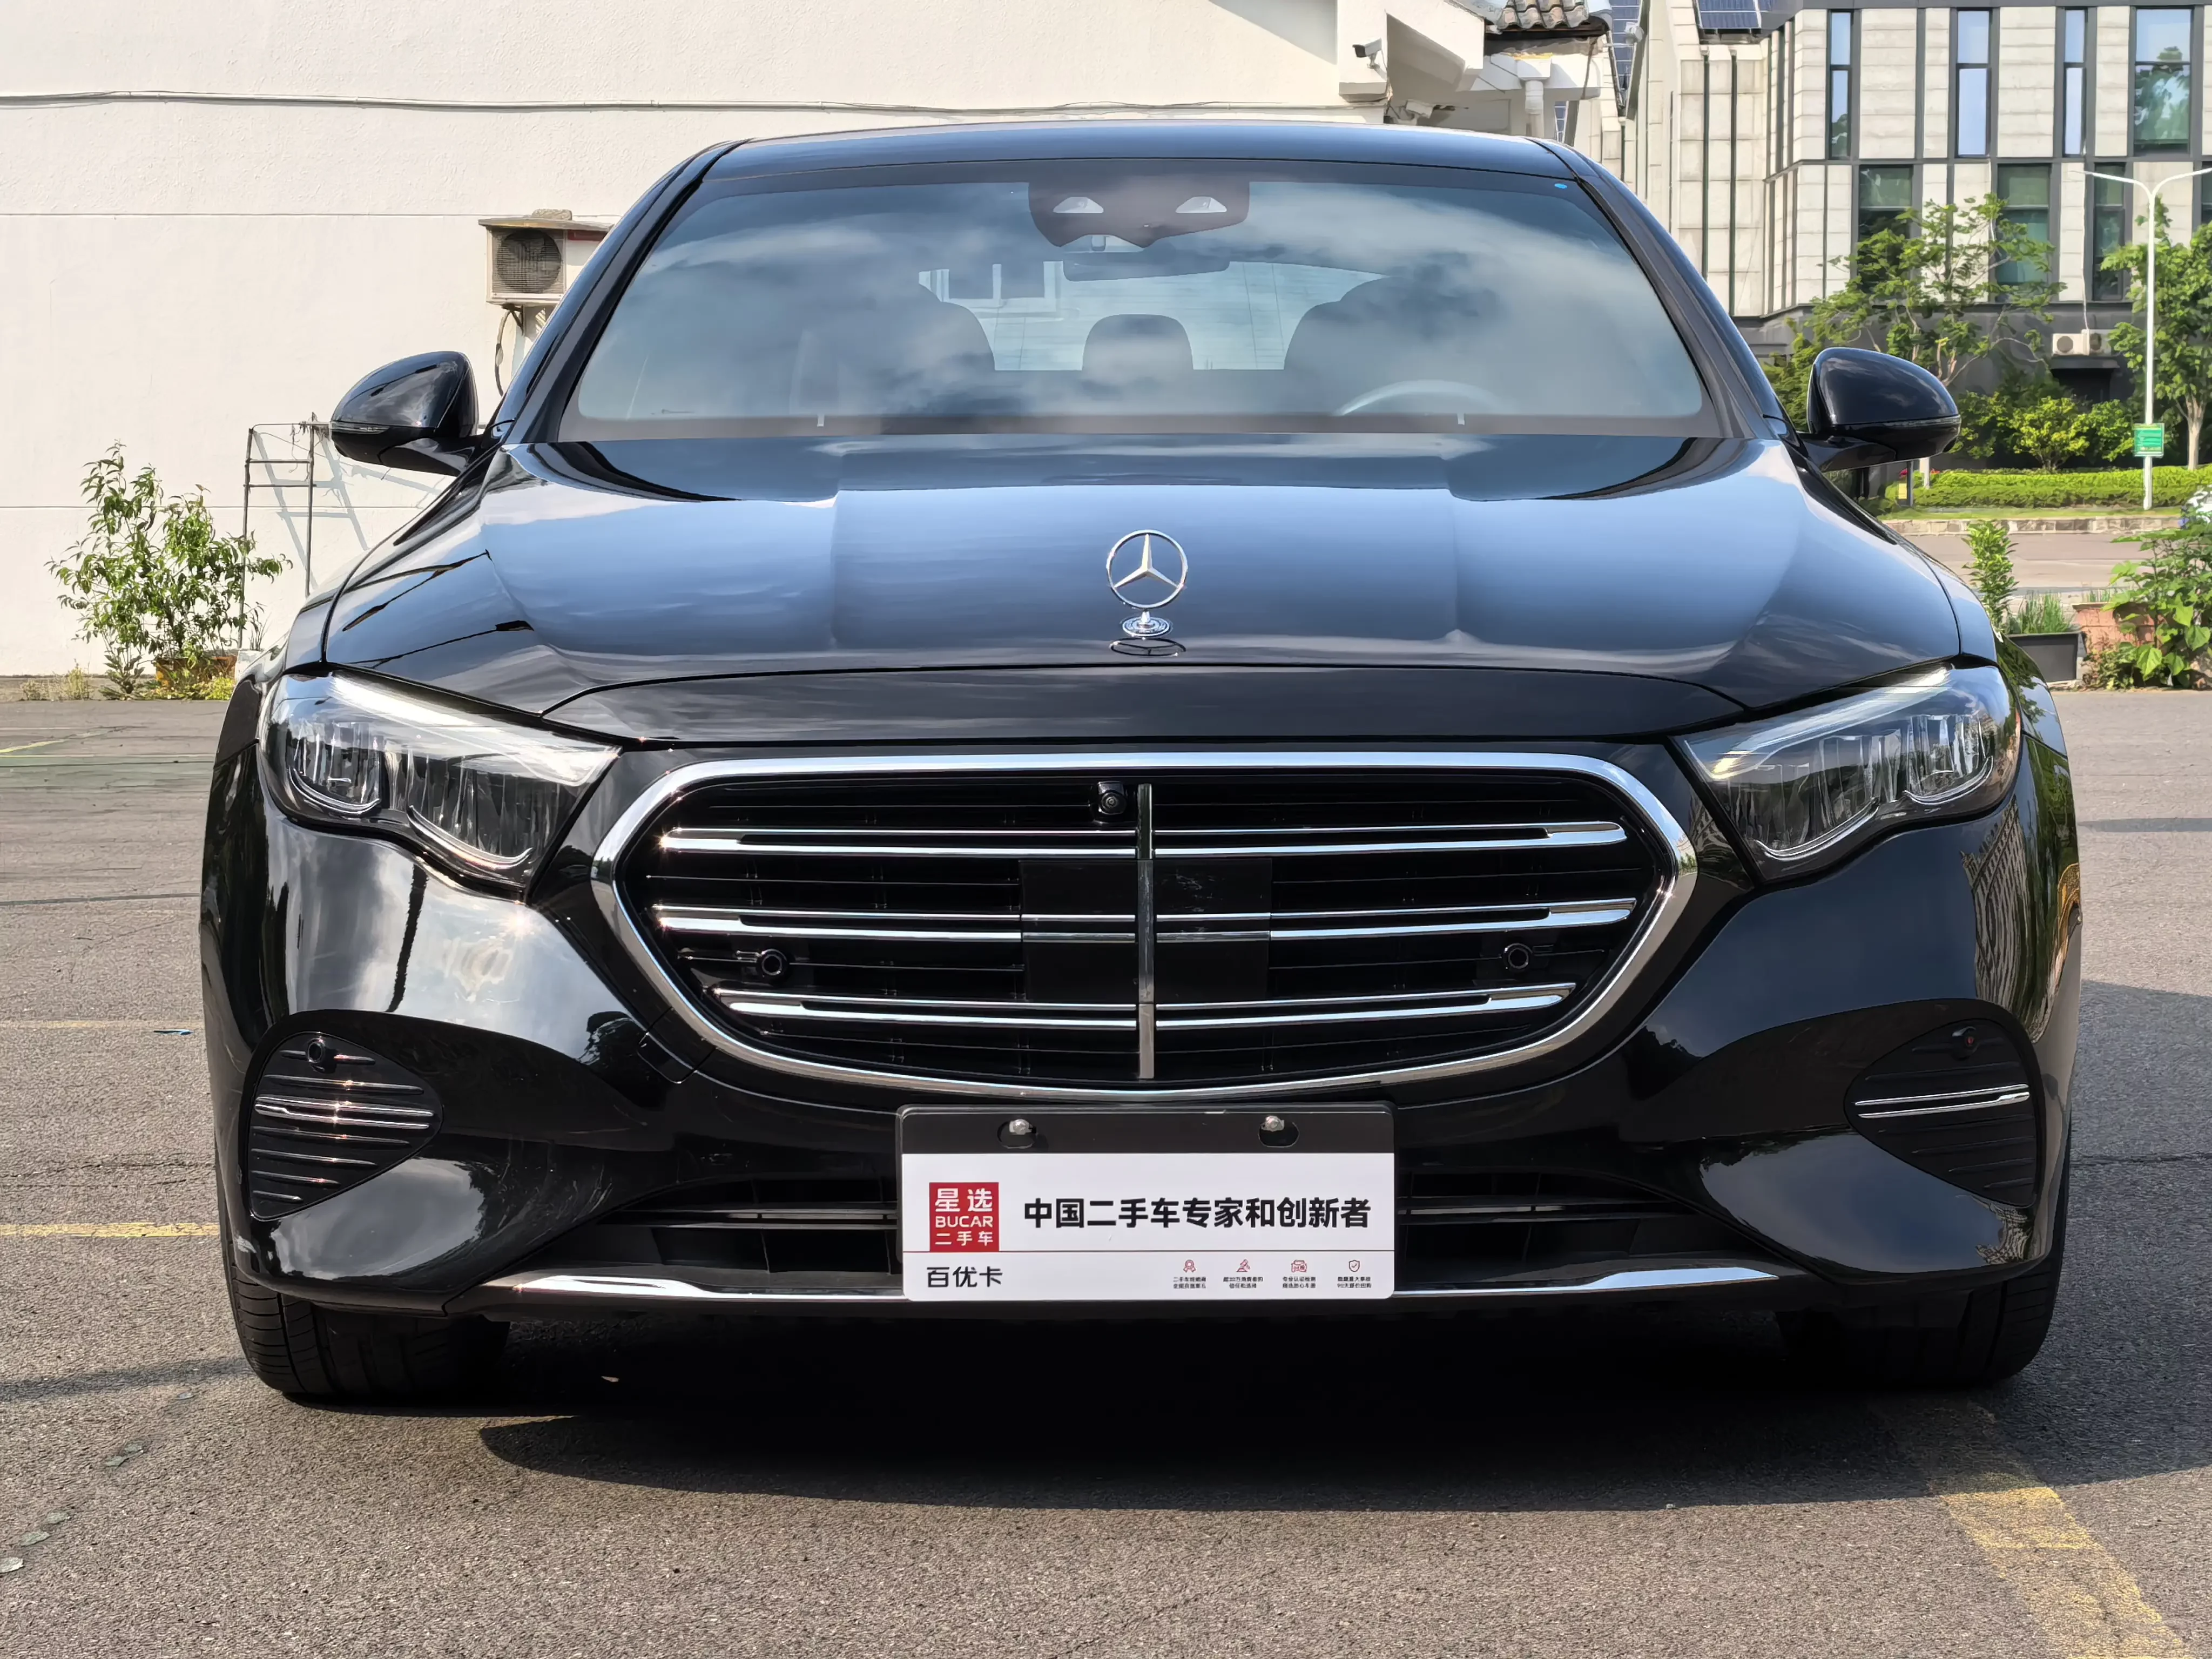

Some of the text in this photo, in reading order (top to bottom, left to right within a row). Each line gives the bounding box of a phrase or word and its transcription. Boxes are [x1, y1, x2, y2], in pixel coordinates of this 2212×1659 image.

[935, 1188, 993, 1212] 星选
[935, 1216, 993, 1228] BUCAR
[1024, 1197, 1371, 1228] 中国二手车专家和创新者
[935, 1231, 993, 1246] 二手车
[927, 1266, 1003, 1287] 百优卡
